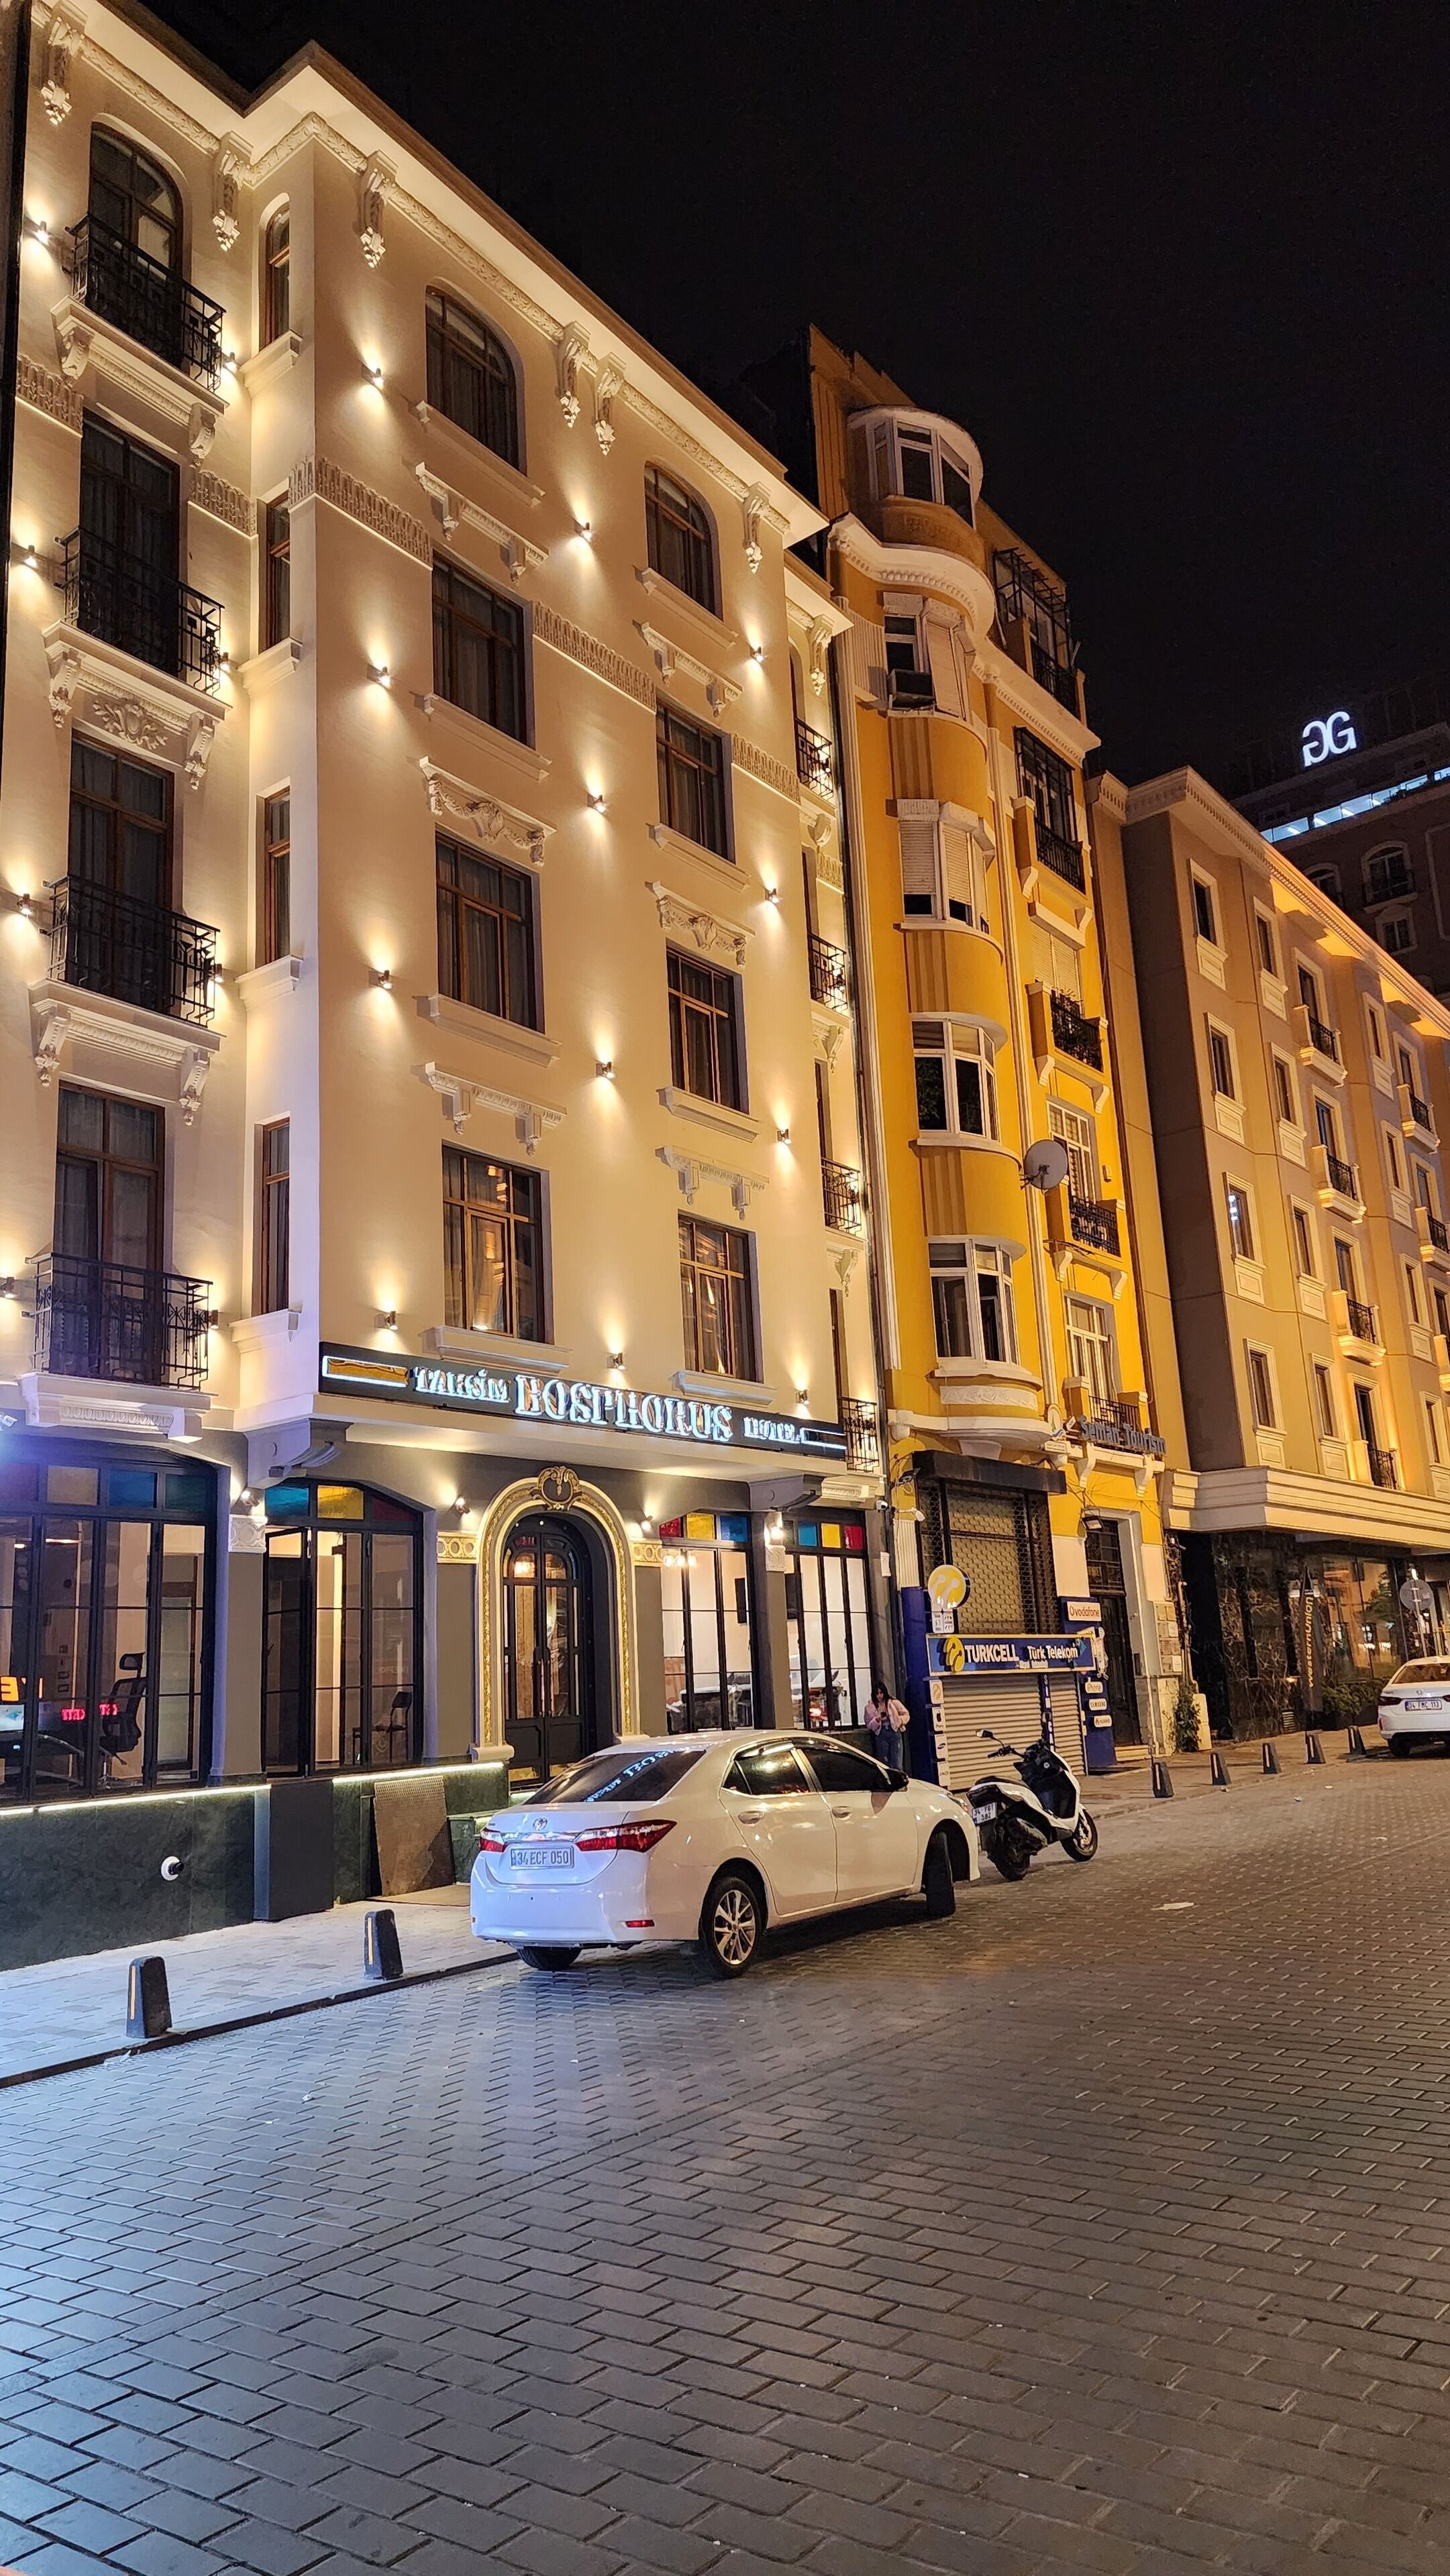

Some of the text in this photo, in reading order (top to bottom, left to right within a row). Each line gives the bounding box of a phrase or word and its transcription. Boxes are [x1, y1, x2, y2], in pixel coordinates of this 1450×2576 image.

[514, 1375, 733, 1442] BOSPHORUS
[964, 1644, 1019, 1663] TURKCELL
[1027, 1645, 1078, 1660] Türk Telekom
[517, 1850, 568, 1865] 34 ECF 050
